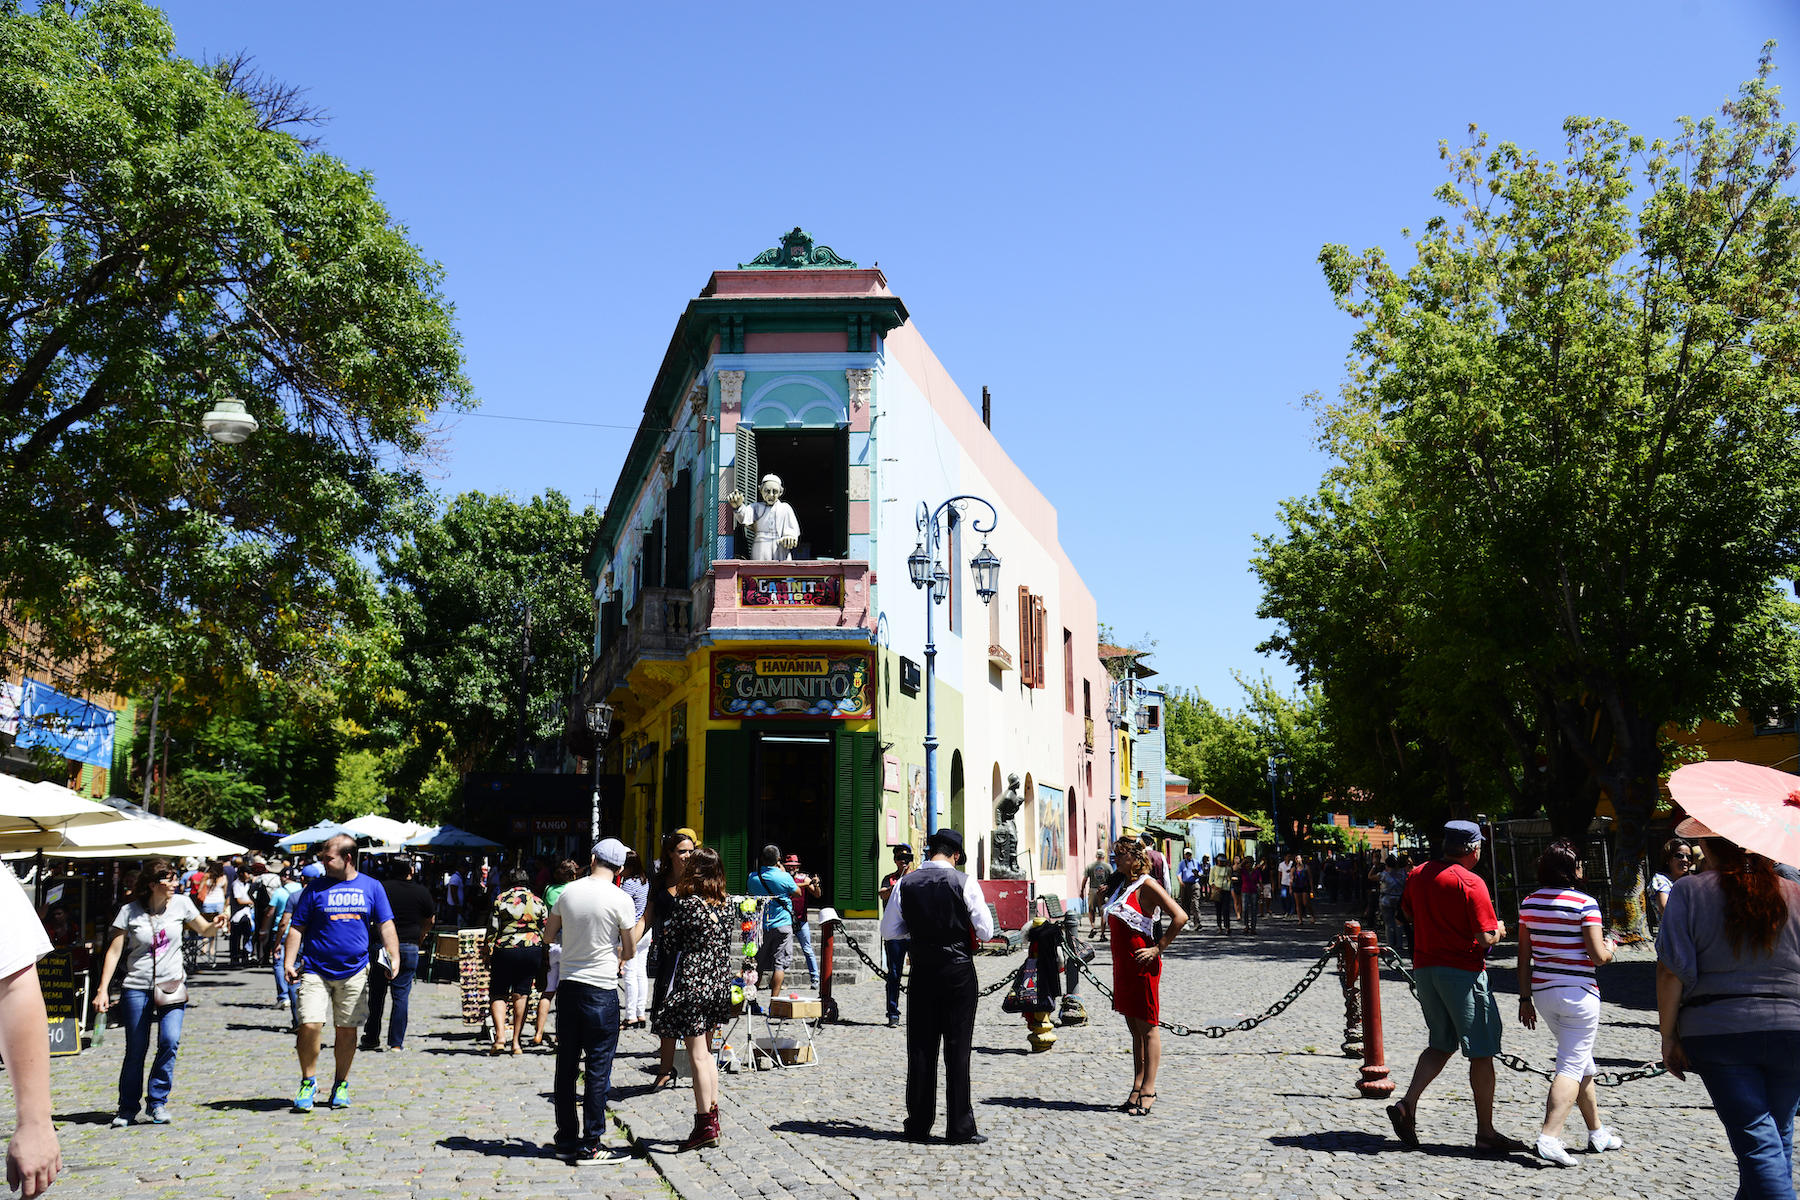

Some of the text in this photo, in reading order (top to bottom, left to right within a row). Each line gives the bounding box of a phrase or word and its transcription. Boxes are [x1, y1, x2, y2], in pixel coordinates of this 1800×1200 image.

[763, 661, 823, 673] HAVANNA
[736, 674, 849, 697] CAMINITO
[536, 821, 567, 829] TANGO
[328, 893, 365, 906] KOOGA
